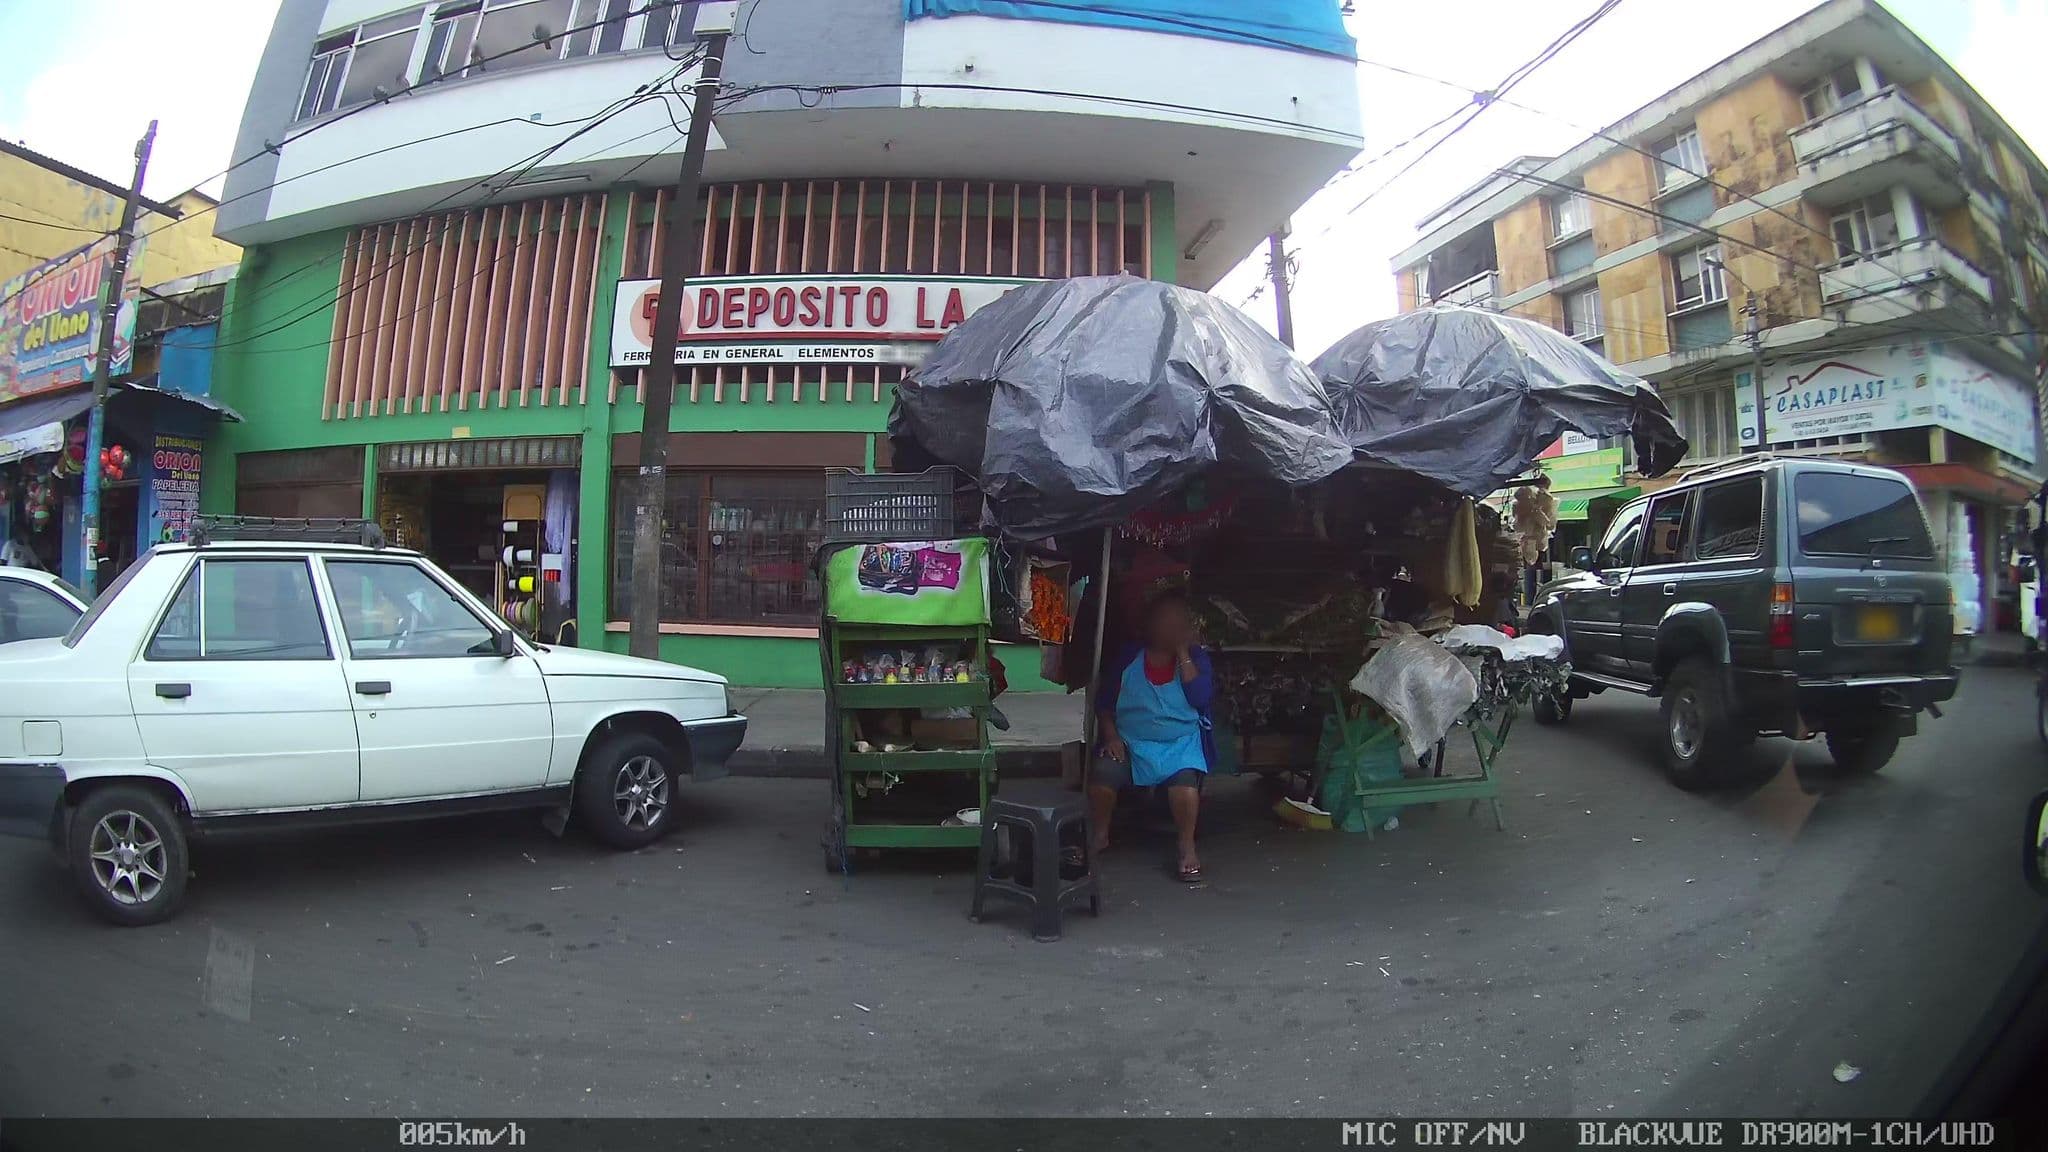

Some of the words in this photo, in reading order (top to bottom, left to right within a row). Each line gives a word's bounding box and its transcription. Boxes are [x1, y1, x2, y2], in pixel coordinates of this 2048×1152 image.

[697, 286, 889, 329] DEPOSITO
[917, 287, 965, 329] LA
[703, 350, 720, 359] EN
[725, 348, 783, 359] GENERAL
[798, 347, 874, 359] ELEMENTOS
[1777, 380, 1884, 412] CASAPLAST
[153, 450, 201, 472] ORION
